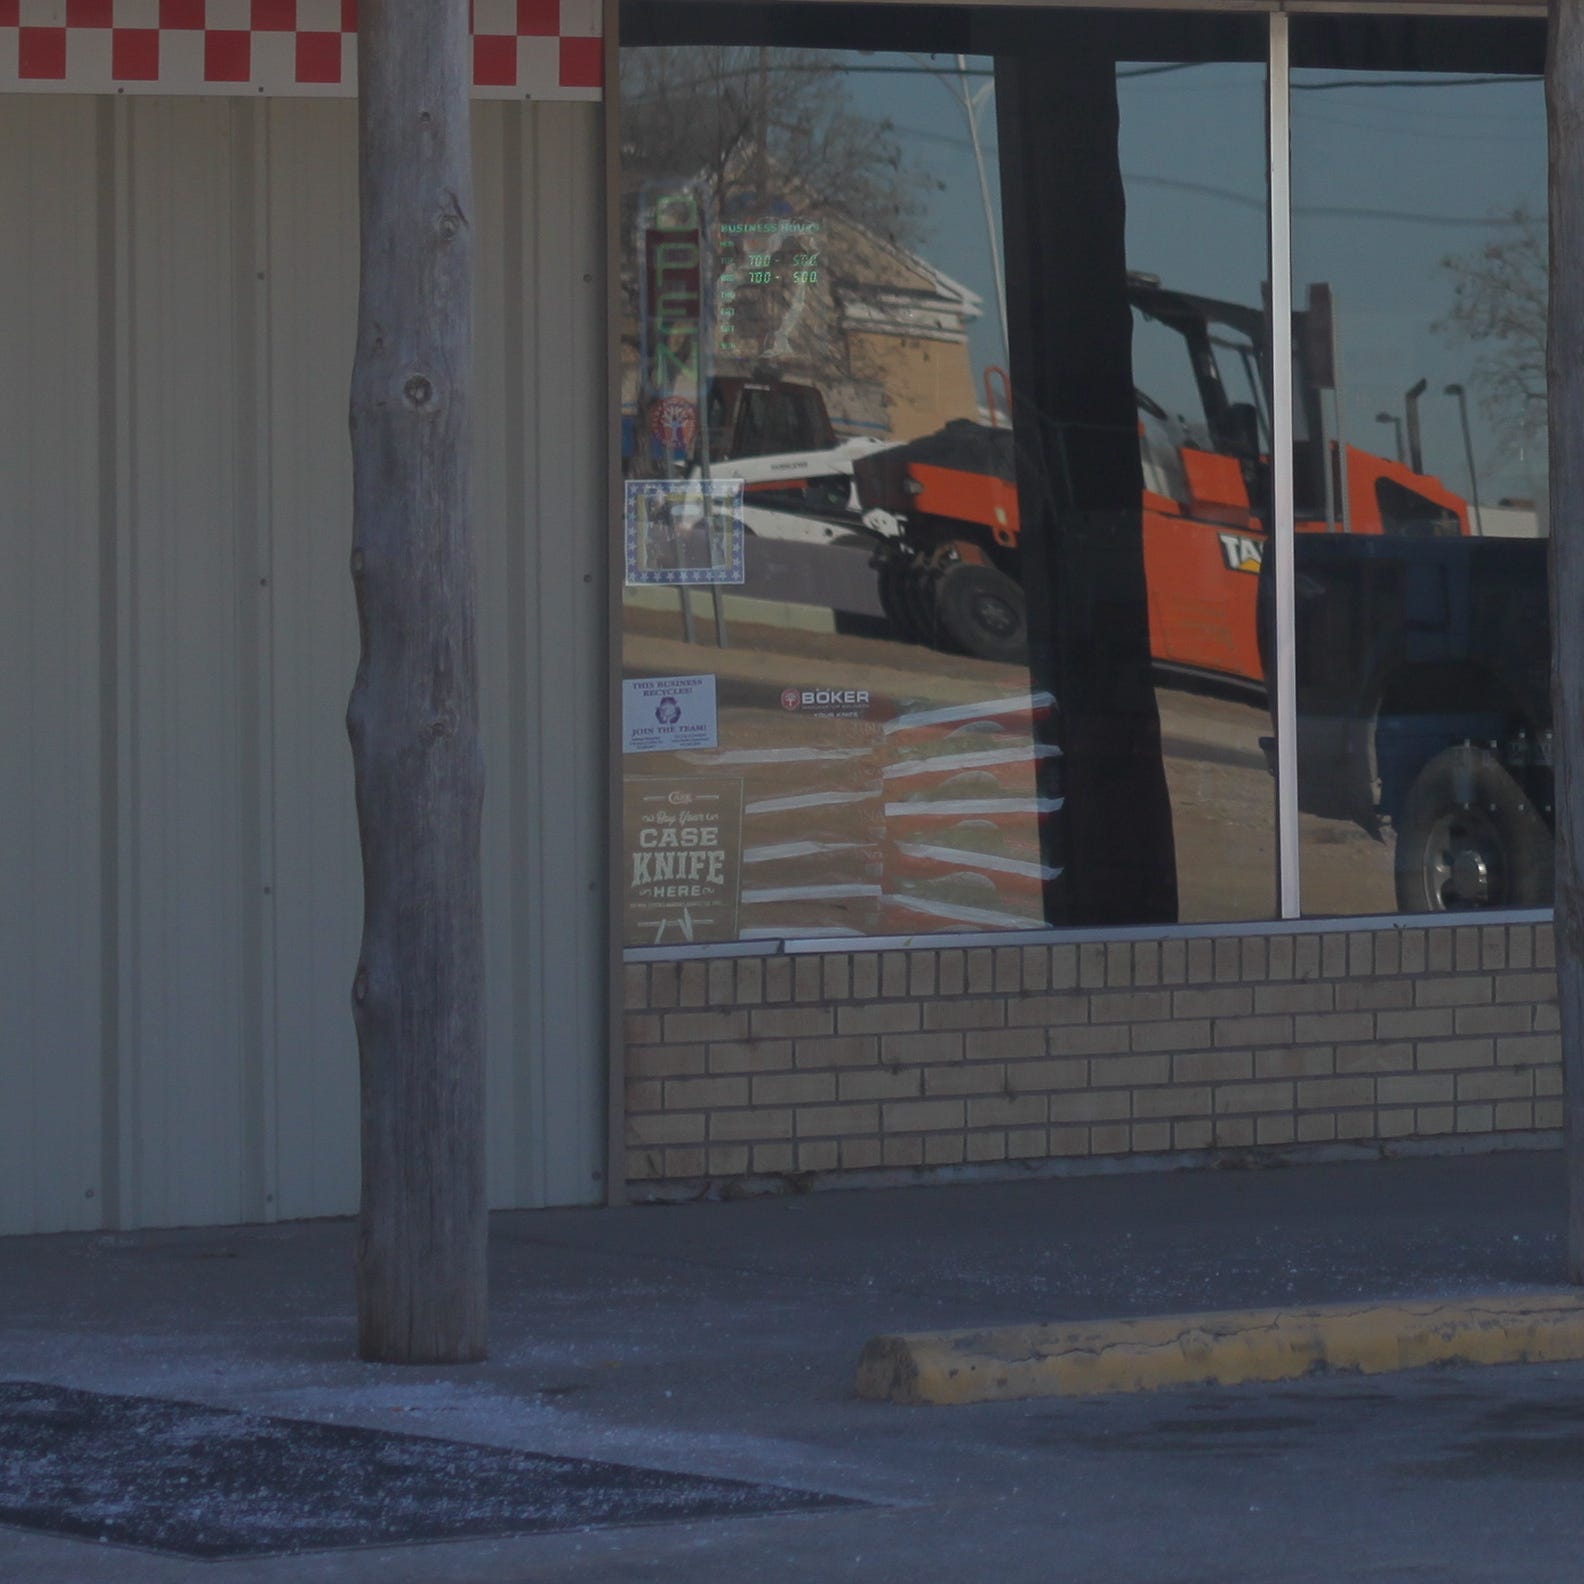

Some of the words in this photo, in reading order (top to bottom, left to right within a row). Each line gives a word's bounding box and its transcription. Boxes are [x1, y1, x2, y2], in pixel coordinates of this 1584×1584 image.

[720, 223, 777, 233] BUSINESS
[655, 195, 699, 386] OPEN
[633, 680, 655, 689] THIS
[657, 678, 703, 688] BUSINESS
[801, 687, 870, 704] BÖKER
[631, 727, 654, 737] JOIN
[657, 726, 674, 734] THE
[679, 724, 707, 733] TEAM!
[639, 827, 719, 848] CASE
[631, 850, 726, 888] KNIFE
[653, 885, 703, 897] HERE
